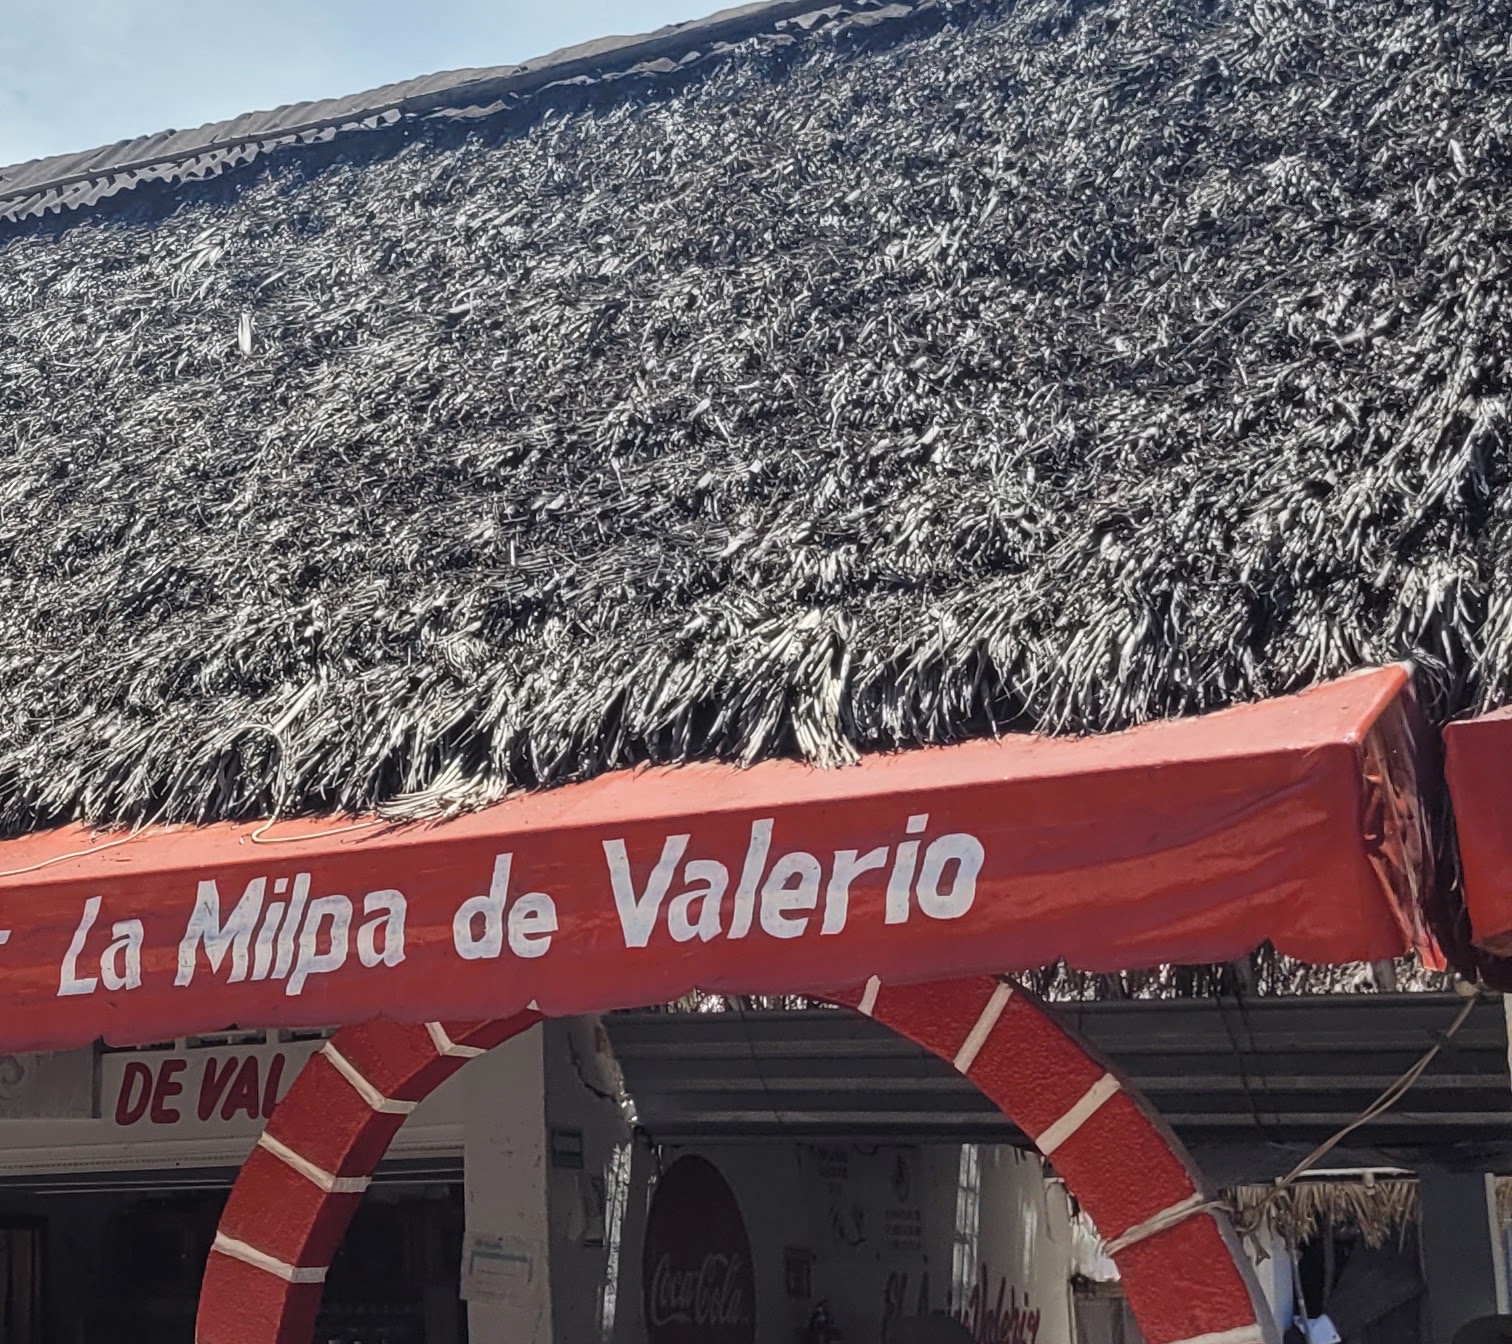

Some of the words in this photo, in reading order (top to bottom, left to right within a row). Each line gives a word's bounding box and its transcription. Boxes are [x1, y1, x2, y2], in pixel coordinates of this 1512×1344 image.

[57, 896, 143, 997] La
[174, 873, 406, 996] Milpa
[453, 854, 558, 960] de
[603, 814, 985, 948] Valerio
[116, 1059, 187, 1126] DE
